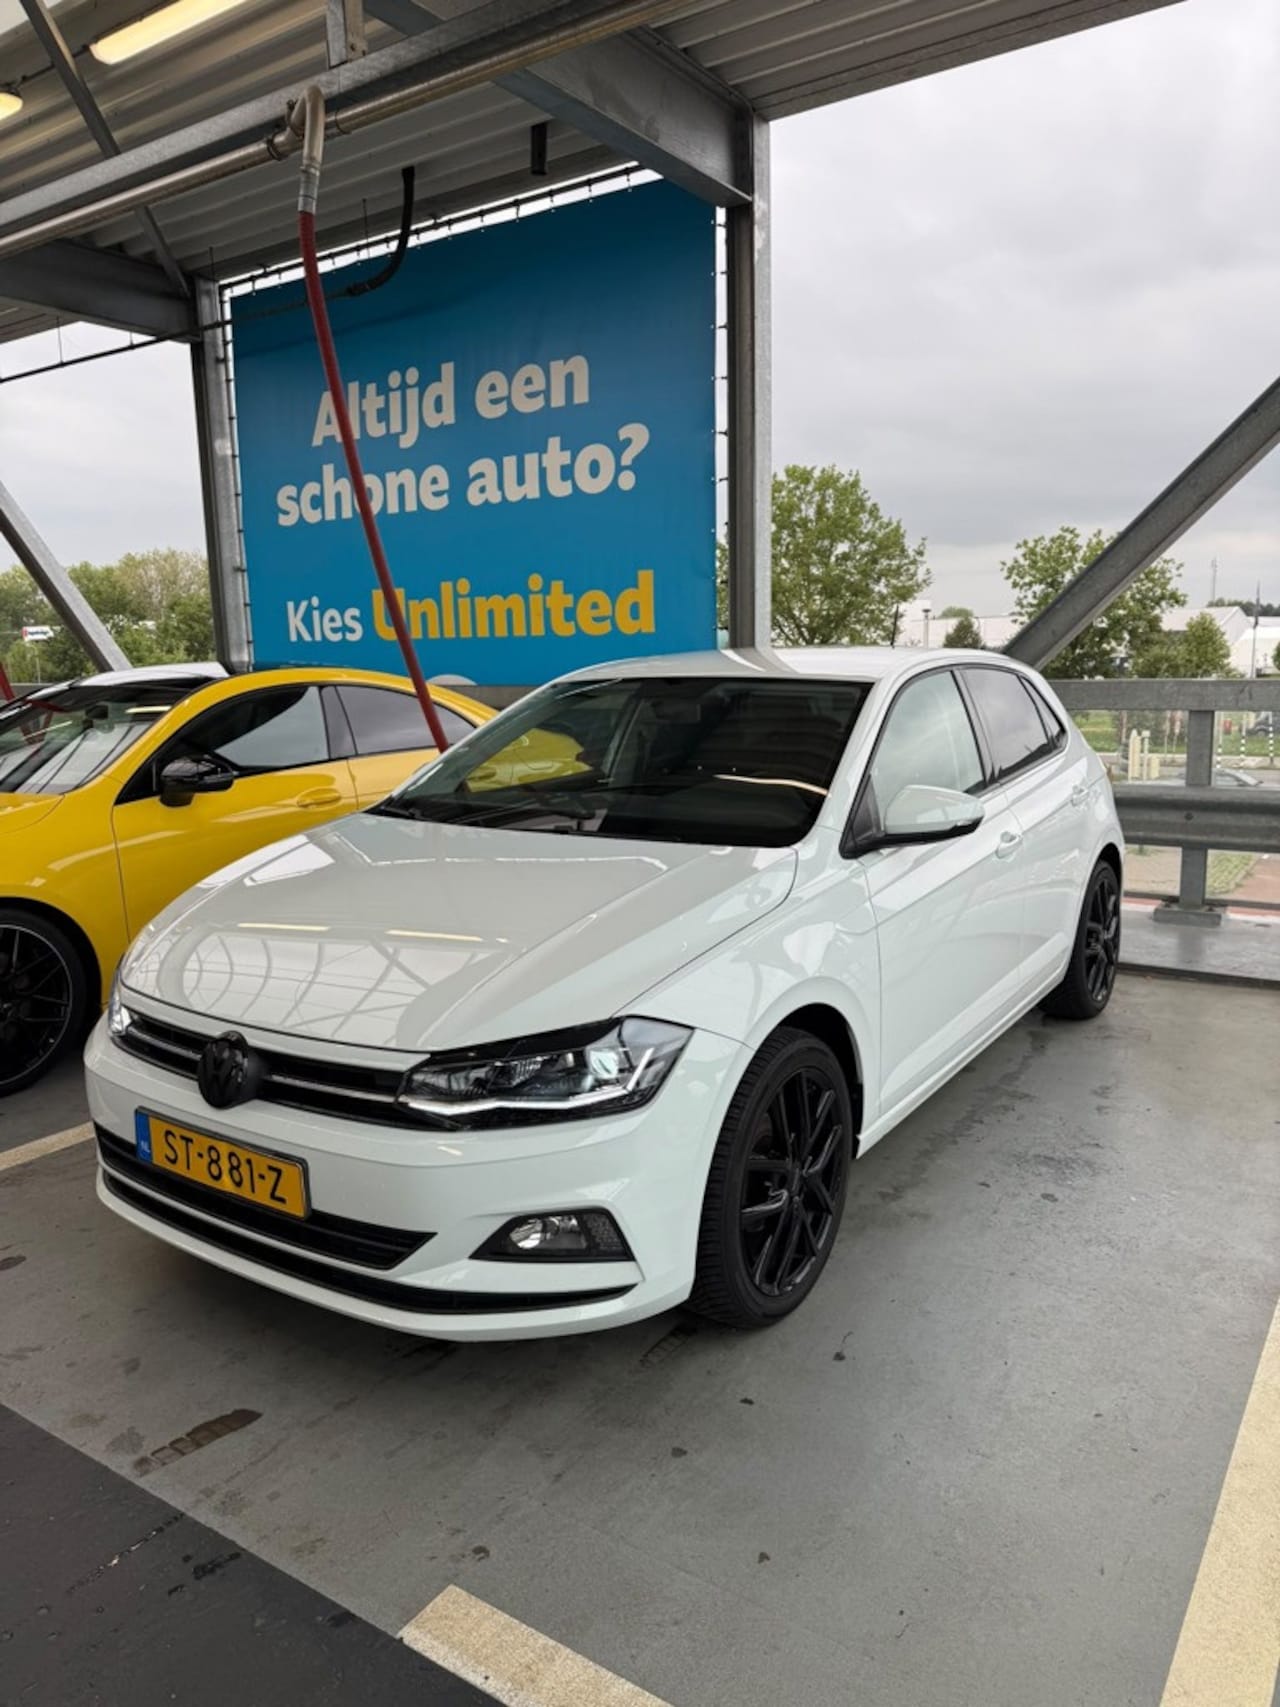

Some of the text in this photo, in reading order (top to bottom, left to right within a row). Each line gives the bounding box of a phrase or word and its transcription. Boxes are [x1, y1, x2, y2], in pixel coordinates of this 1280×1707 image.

[312, 354, 590, 449] Altijd een
[276, 423, 650, 526] schone auto?
[287, 569, 656, 642] Kies Unlimited
[164, 1130, 287, 1204] ST-881-Z
